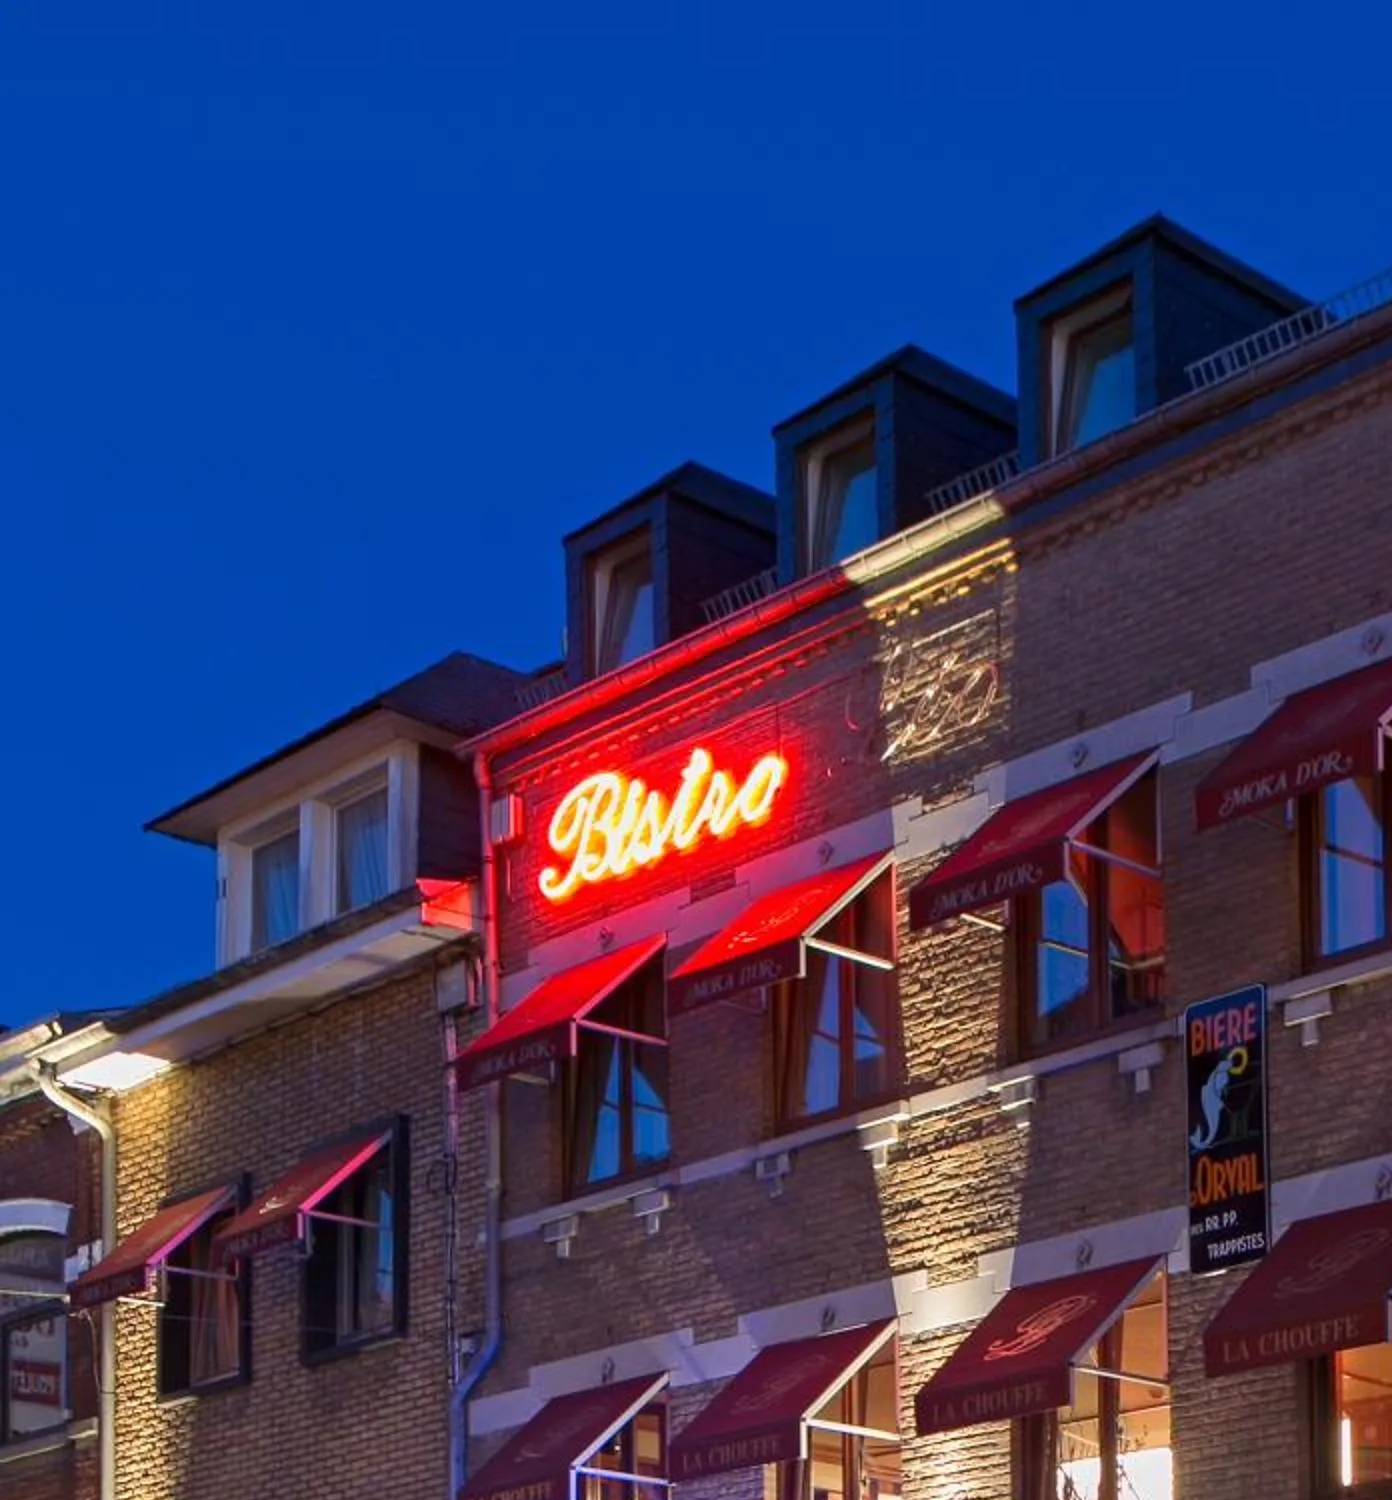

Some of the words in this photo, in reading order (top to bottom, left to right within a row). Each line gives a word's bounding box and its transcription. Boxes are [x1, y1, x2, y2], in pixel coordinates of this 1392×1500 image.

[1218, 770, 1287, 817] MOKA
[539, 747, 788, 898] Bistro
[1207, 1232, 1265, 1261] TRAPPISTES
[1223, 1340, 1250, 1363] LA
[1259, 1315, 1360, 1356] CHOUFFE
